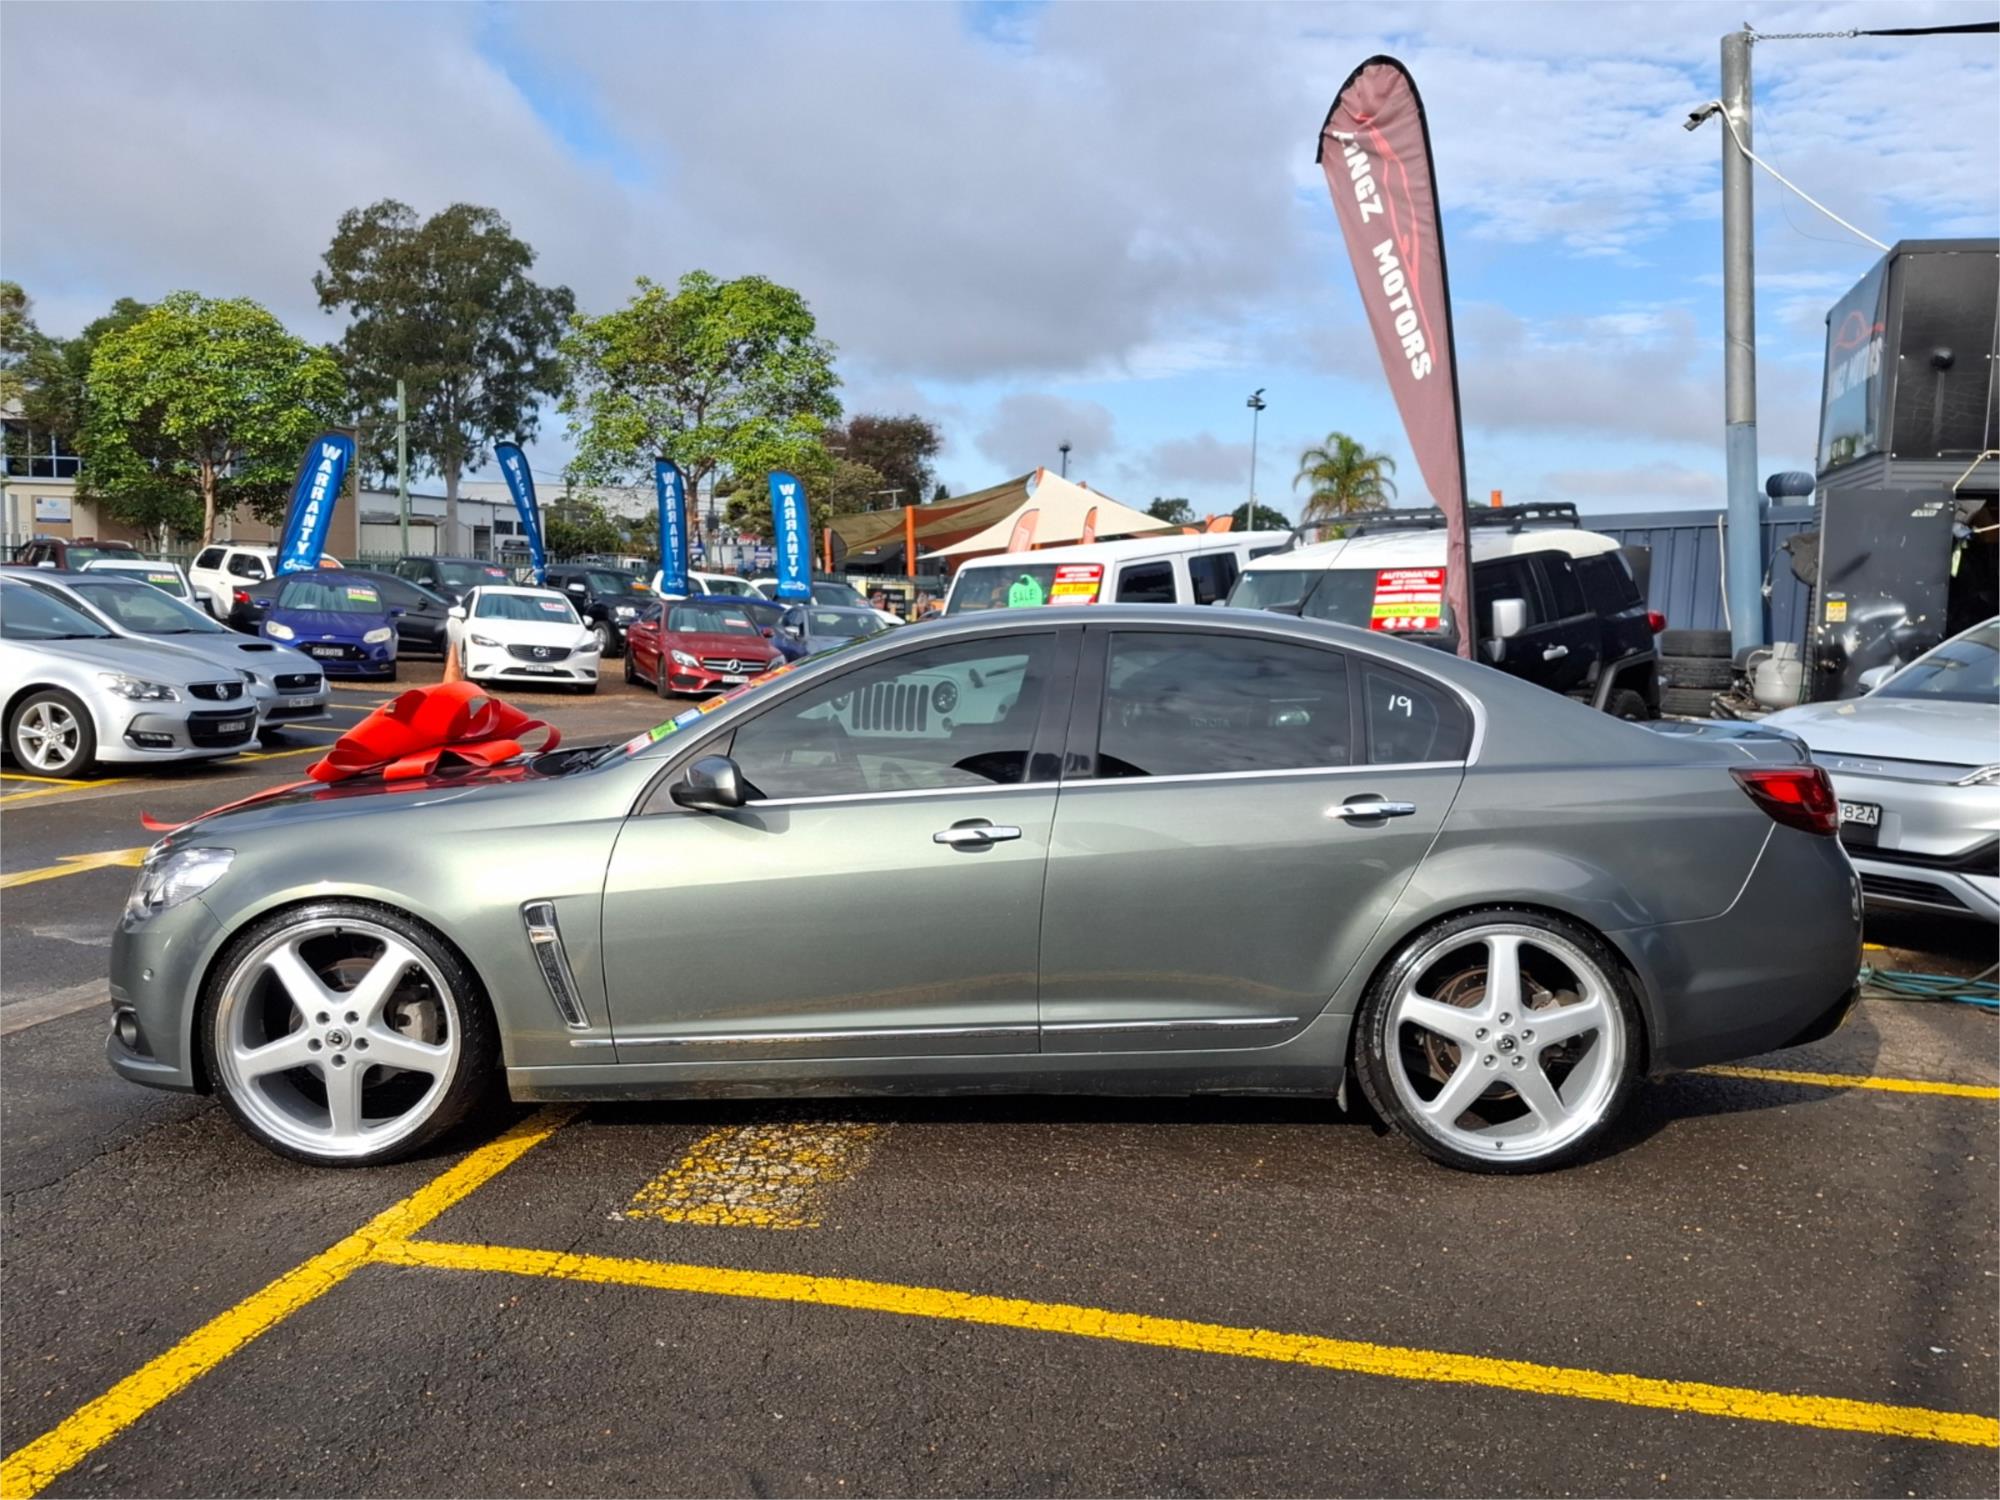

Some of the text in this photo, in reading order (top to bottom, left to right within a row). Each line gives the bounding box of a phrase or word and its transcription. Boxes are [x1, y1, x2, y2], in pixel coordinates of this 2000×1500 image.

[1372, 239, 1432, 381] MOTORS
[296, 443, 343, 555] WARRANTY
[1381, 570, 1440, 580] AUTOMATIC
[1413, 605, 1438, 614] Tested
[1388, 694, 1412, 717] 19
